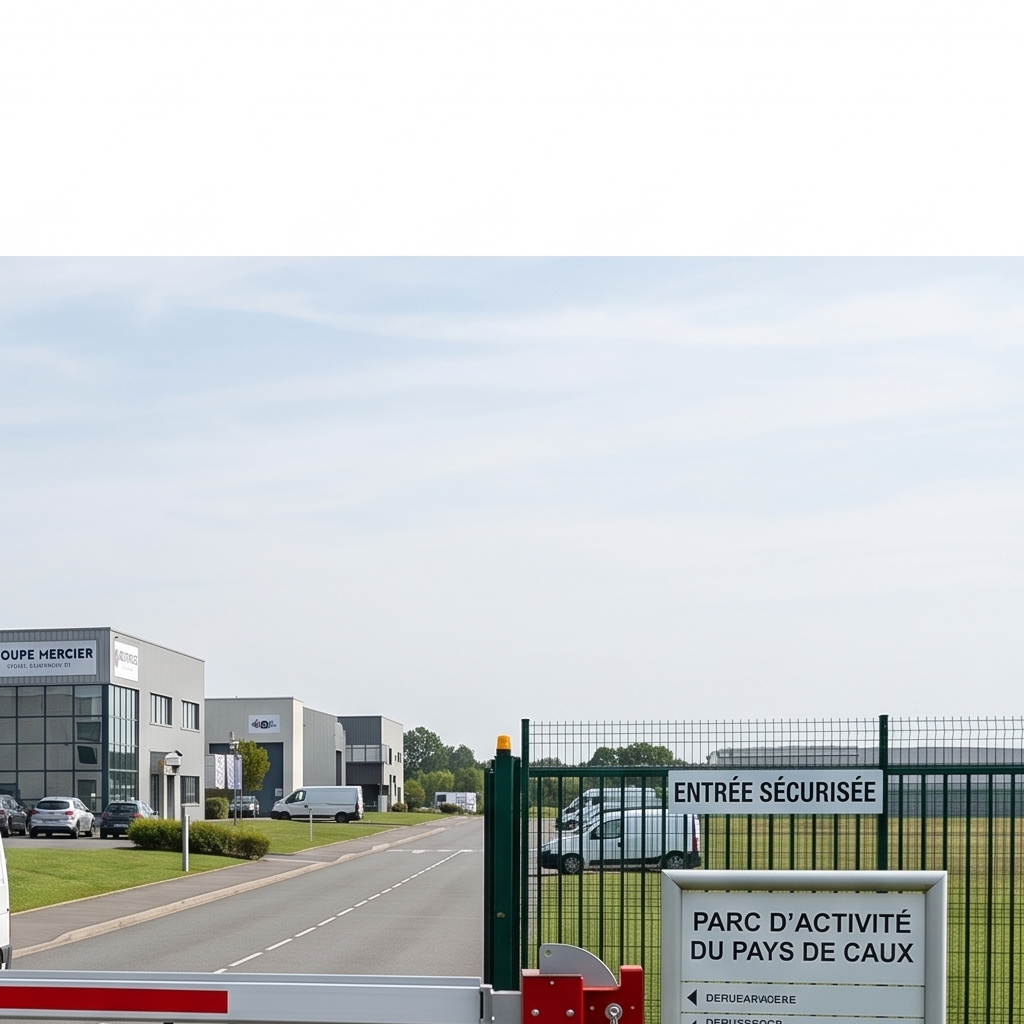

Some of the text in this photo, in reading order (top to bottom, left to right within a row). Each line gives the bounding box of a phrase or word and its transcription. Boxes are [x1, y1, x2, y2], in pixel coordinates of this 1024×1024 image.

[39, 648, 93, 660] MERCIER
[674, 776, 876, 803] ENTRÉE SÉCURISÉE
[693, 909, 912, 934] PARC D'ACTIVITÉ
[691, 941, 914, 963] DU PAYS DE CAUX
